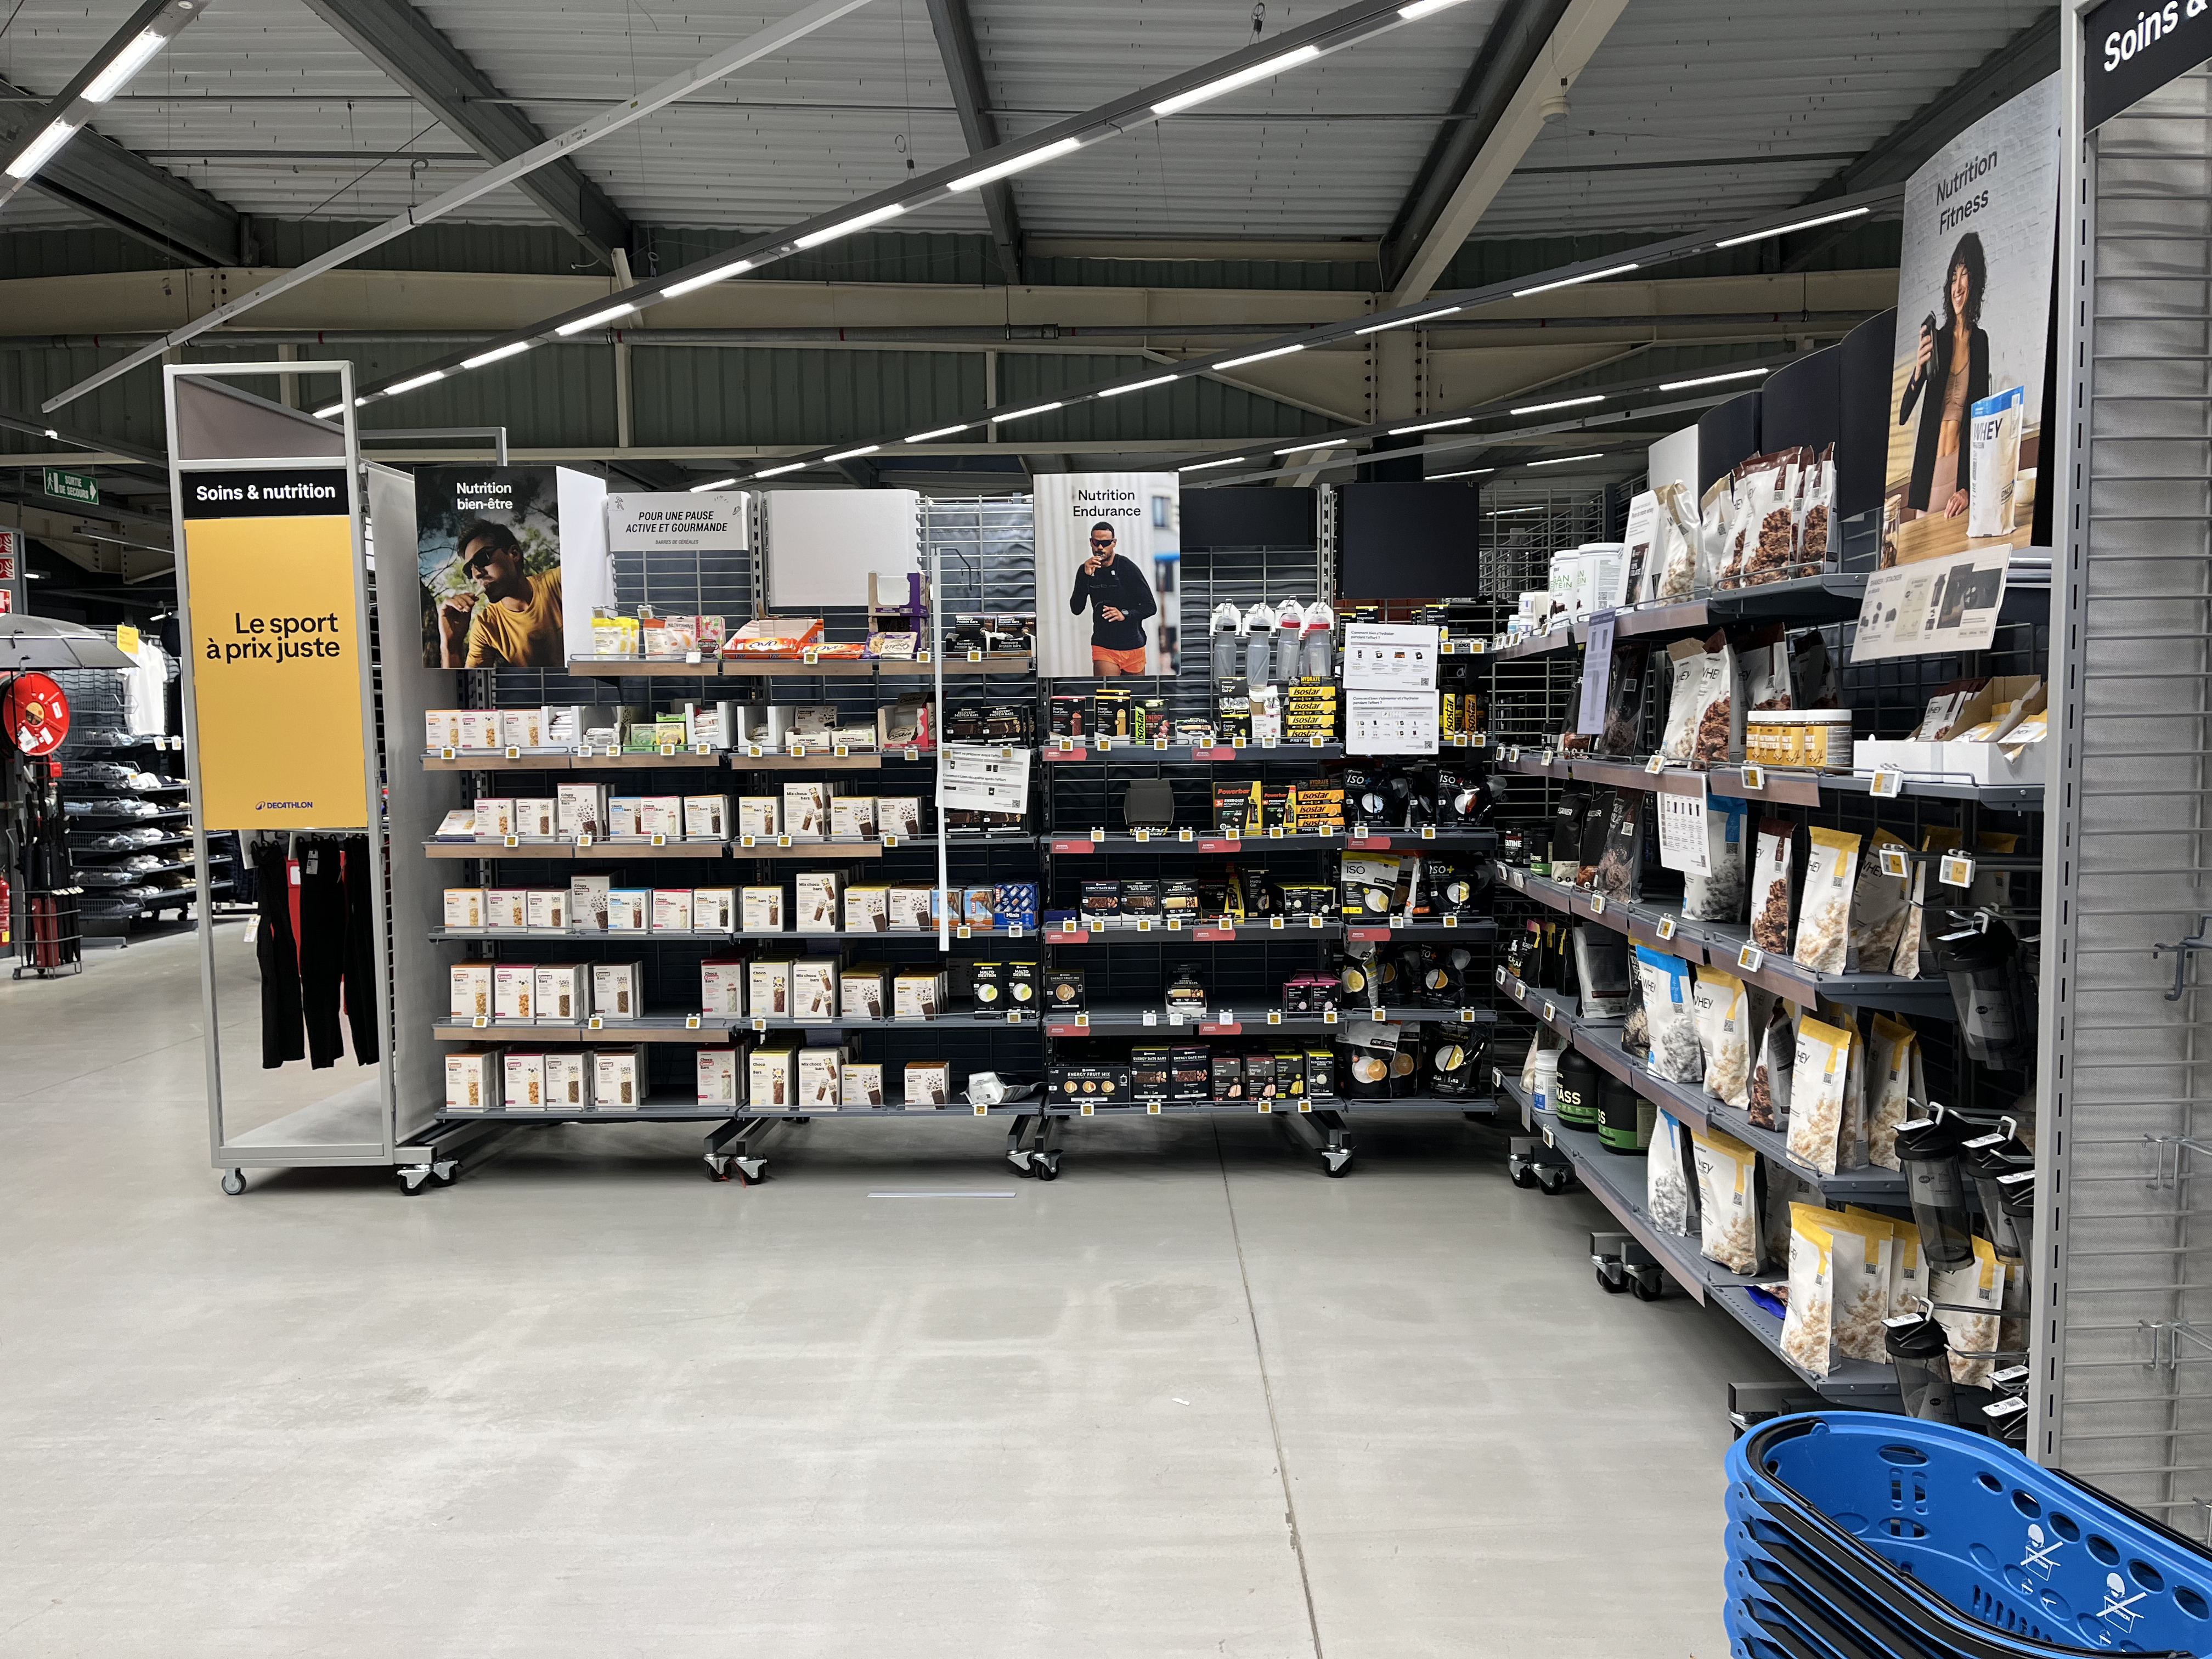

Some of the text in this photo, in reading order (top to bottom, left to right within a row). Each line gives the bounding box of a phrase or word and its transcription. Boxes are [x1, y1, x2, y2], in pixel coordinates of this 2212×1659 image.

[2103, 11, 2179, 72] Soins
[1936, 150, 1997, 206] Nutrition
[1939, 189, 1989, 235] Fitness
[1974, 417, 2003, 441] WHEY
[65, 475, 82, 487] SORTIE
[59, 484, 89, 499] DE SECOURS
[196, 483, 336, 501] Soins & nutrition
[456, 482, 512, 494] Nutrition
[1079, 489, 1135, 501] Nutrition
[456, 496, 513, 511] bien-être
[639, 511, 714, 521] POUR UNE PAUSE
[1073, 505, 1141, 517] Endurance
[625, 522, 728, 533] ACTIVE ET GOURMANDE
[235, 612, 338, 639] Le sport
[206, 636, 340, 664] à prix juste
[1293, 687, 1321, 696] isostar
[1293, 702, 1321, 710] isostar
[1445, 698, 1454, 732] isostar
[1468, 699, 1476, 733] isostar
[1137, 711, 1145, 741] isostar
[1302, 792, 1329, 800] isostar
[1299, 805, 1327, 814] isostar
[1505, 839, 1522, 848] EATINE
[1346, 866, 1365, 874] ISO
